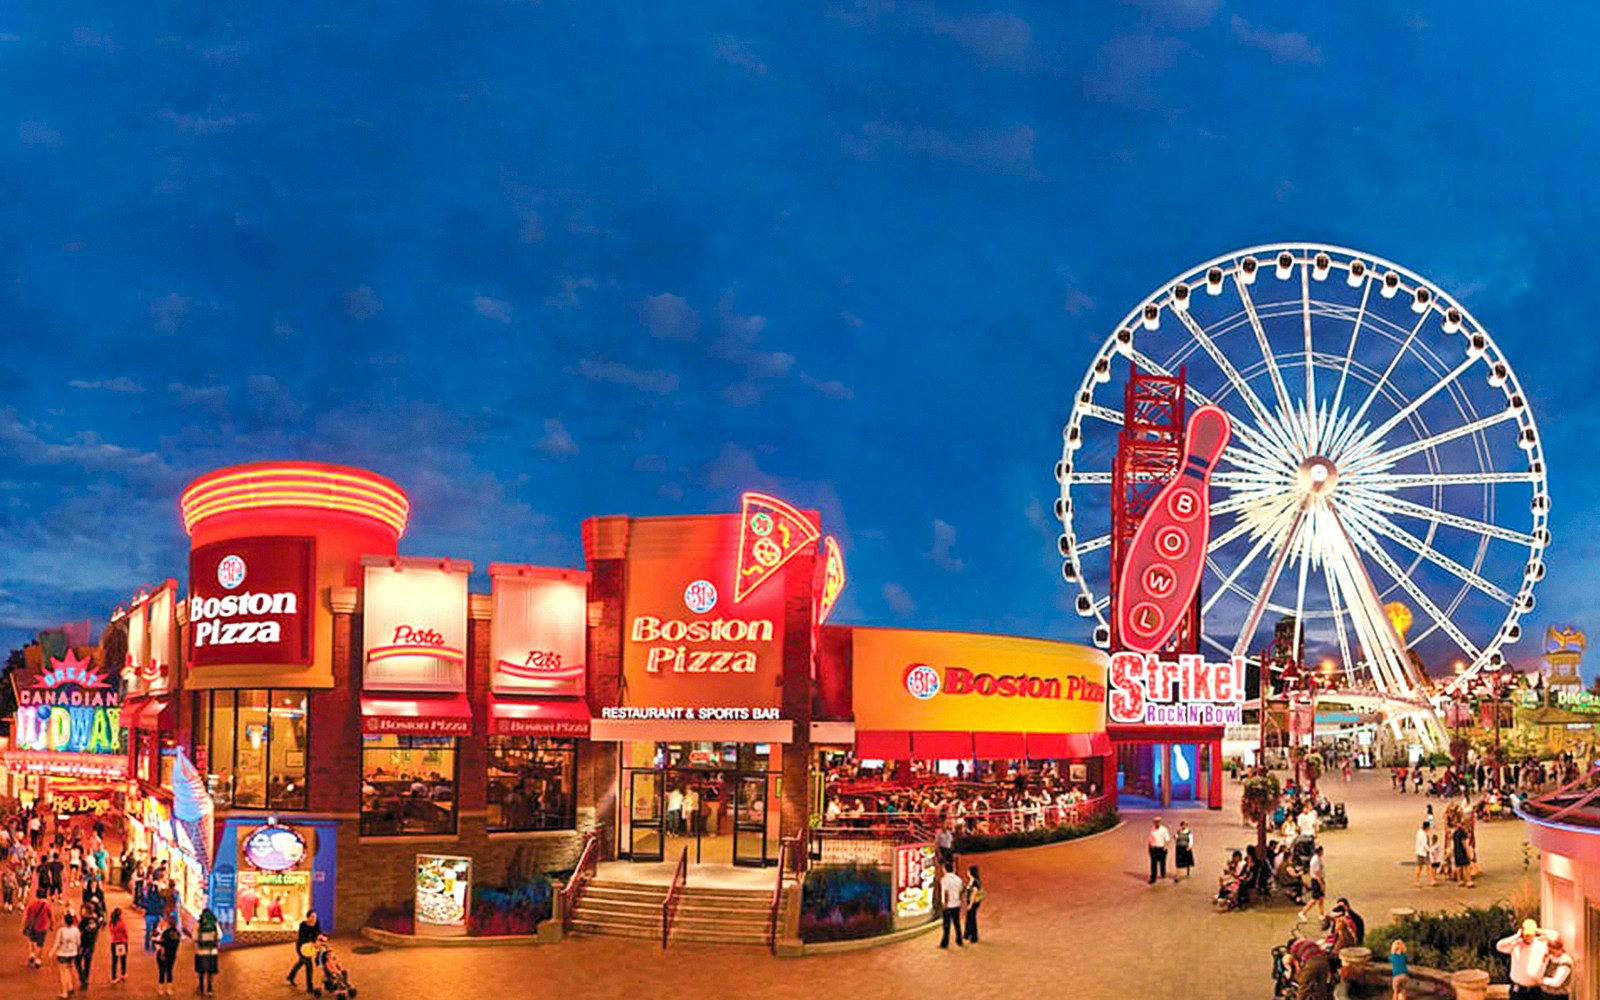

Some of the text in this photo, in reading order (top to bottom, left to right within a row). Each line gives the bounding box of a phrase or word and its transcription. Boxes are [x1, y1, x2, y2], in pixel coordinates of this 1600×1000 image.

[190, 592, 297, 622] Boston
[195, 619, 281, 647] Pizza
[392, 624, 445, 646] Pasta
[631, 616, 774, 642] Boston
[524, 650, 562, 668] Ribs
[646, 646, 758, 673] Pizza
[44, 666, 98, 687] GREAT
[943, 666, 1061, 699] Boston
[1109, 652, 1245, 721] Strike!
[20, 689, 119, 707] CANADIAN
[601, 707, 780, 720] RESTAURANT & SPORTS BAR
[1146, 705, 1185, 723] Rock
[1204, 705, 1240, 723] Bowl
[380, 719, 467, 732] Boston Pizza
[510, 721, 554, 732] Boston
[52, 795, 110, 816] Hot Dogs
